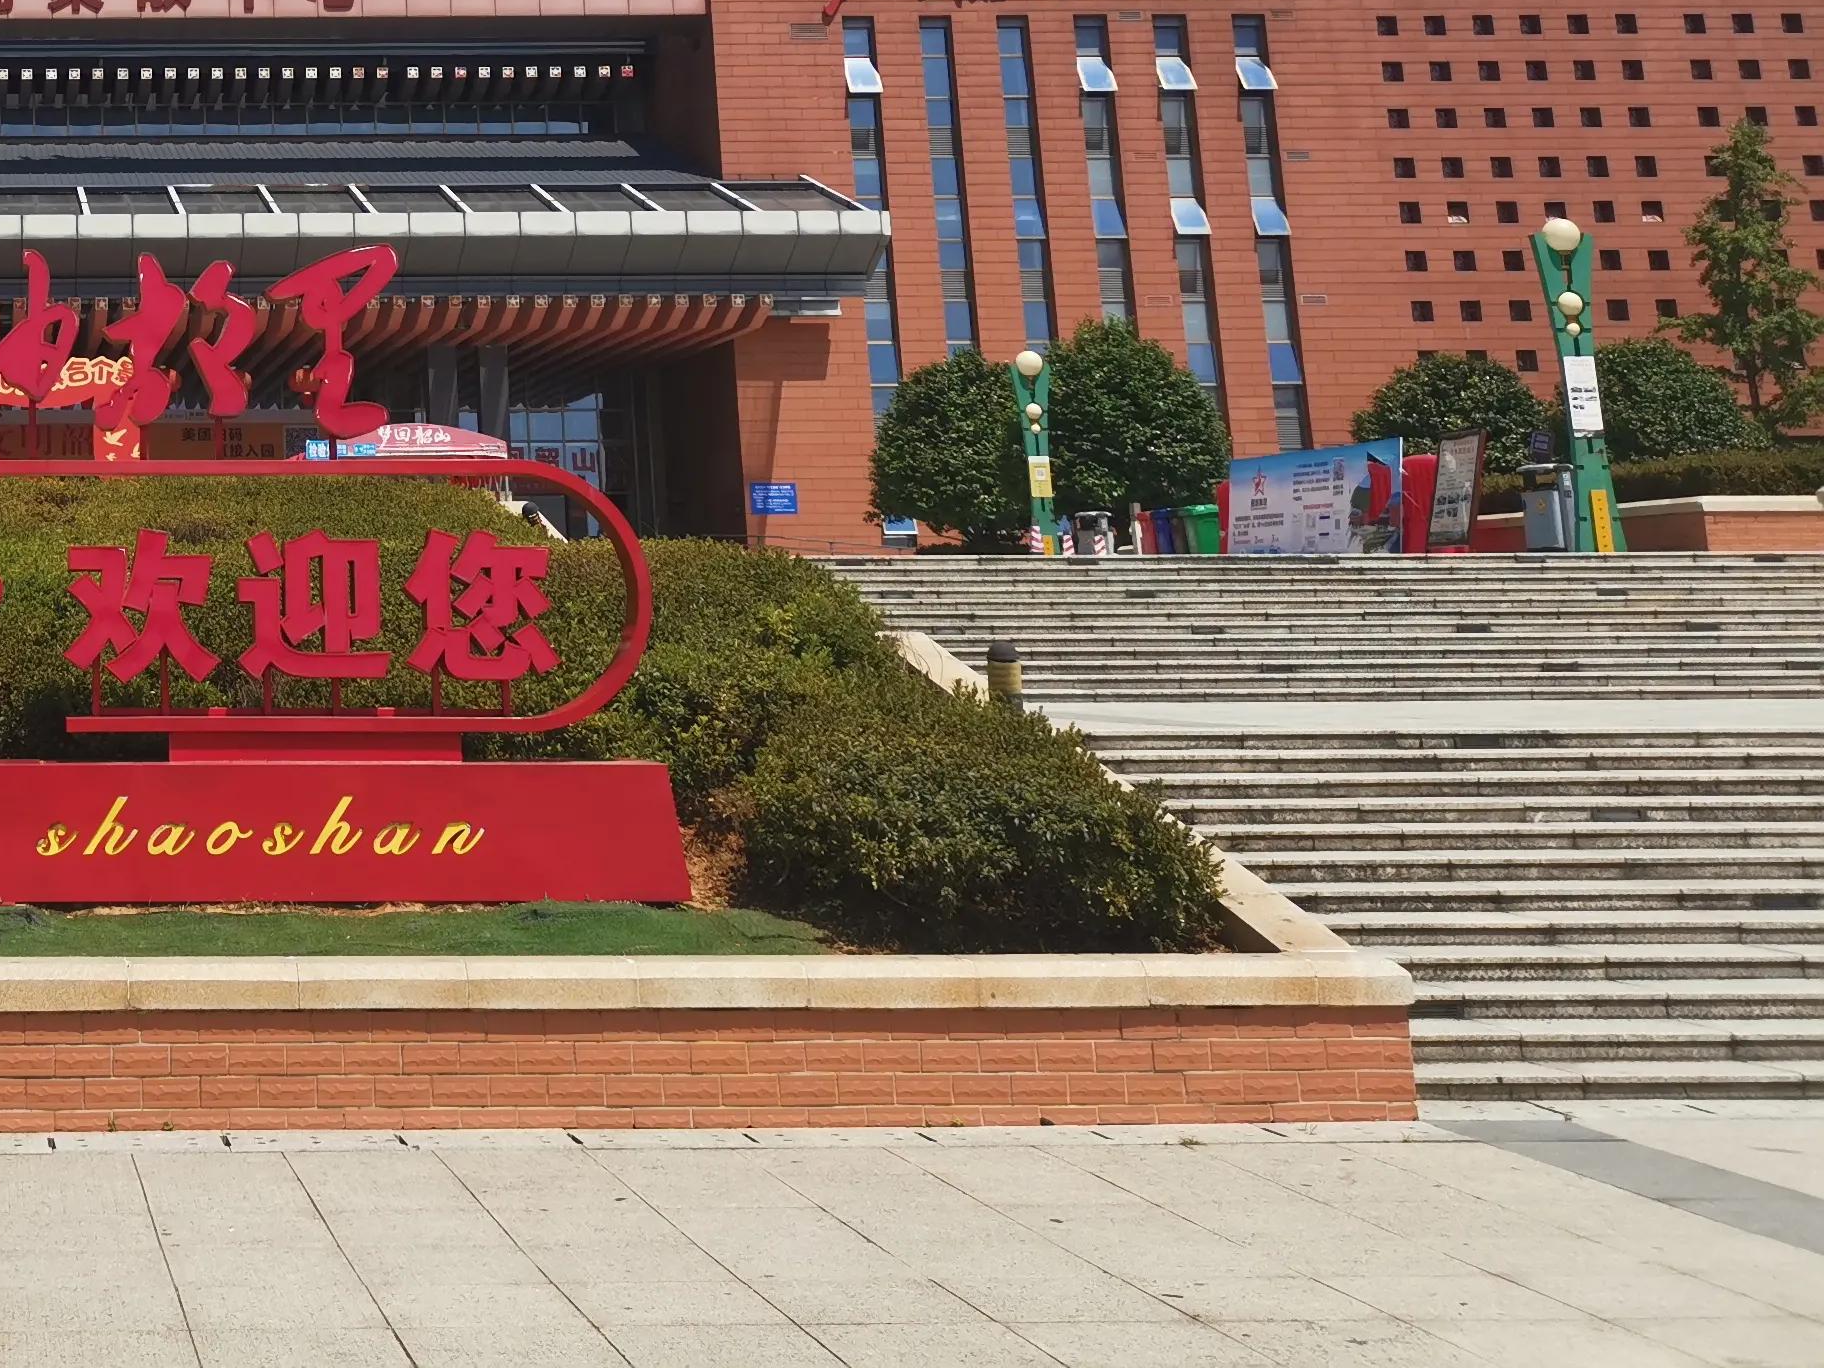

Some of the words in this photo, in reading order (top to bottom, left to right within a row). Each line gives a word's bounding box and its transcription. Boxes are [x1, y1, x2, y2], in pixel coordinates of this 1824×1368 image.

[62, 527, 562, 684] 欢迎您
[35, 794, 486, 858] shaoshan
